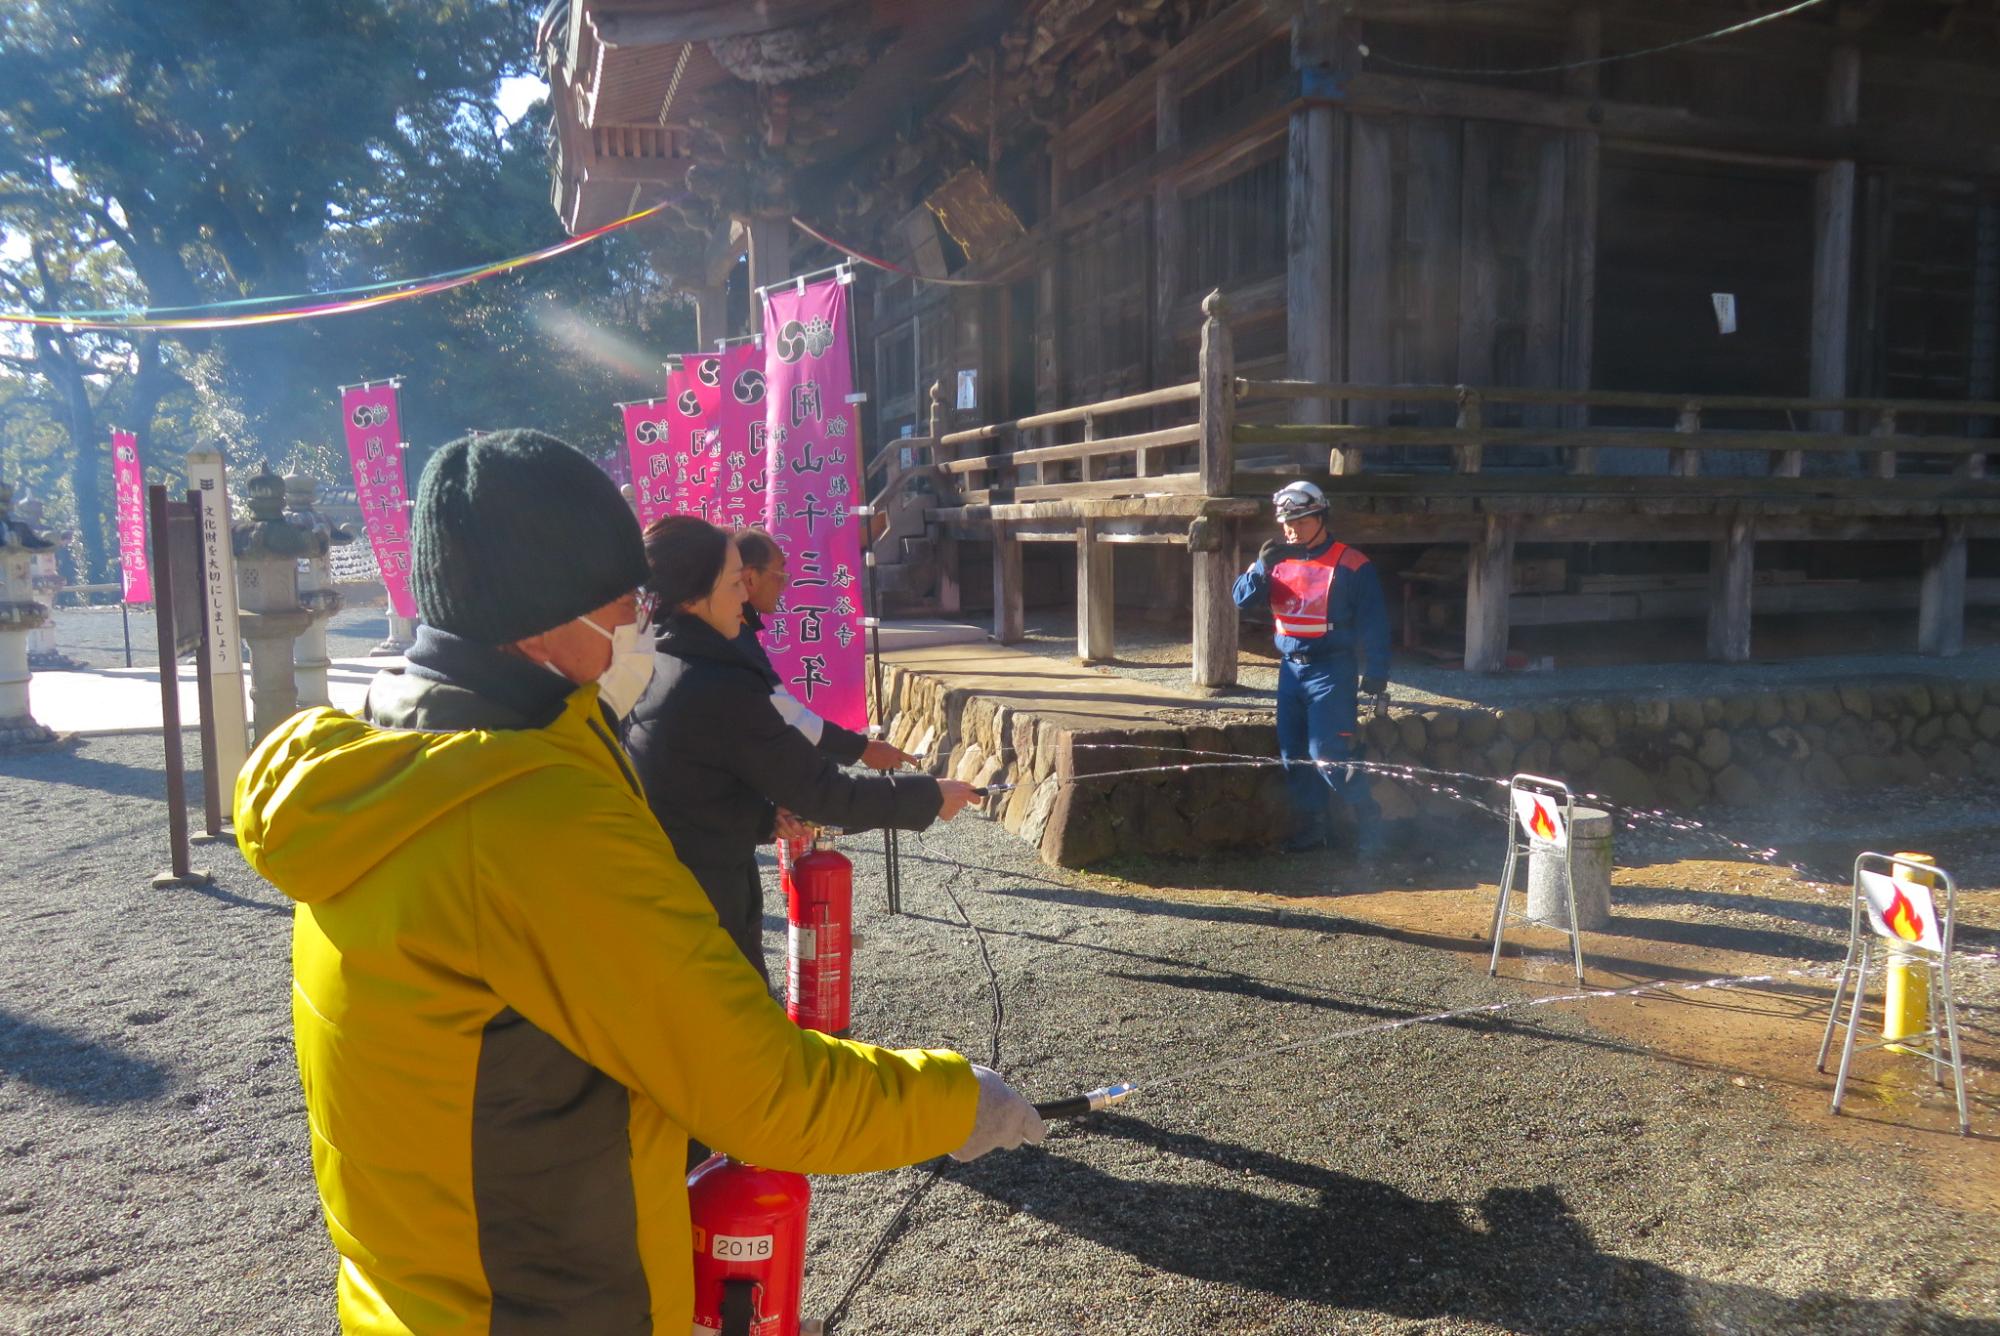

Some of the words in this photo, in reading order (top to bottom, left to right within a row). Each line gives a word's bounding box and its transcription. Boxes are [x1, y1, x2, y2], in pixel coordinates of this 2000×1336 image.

[204, 506, 227, 662] 文化財を大切にしましょう
[717, 1239, 770, 1257] 2018
